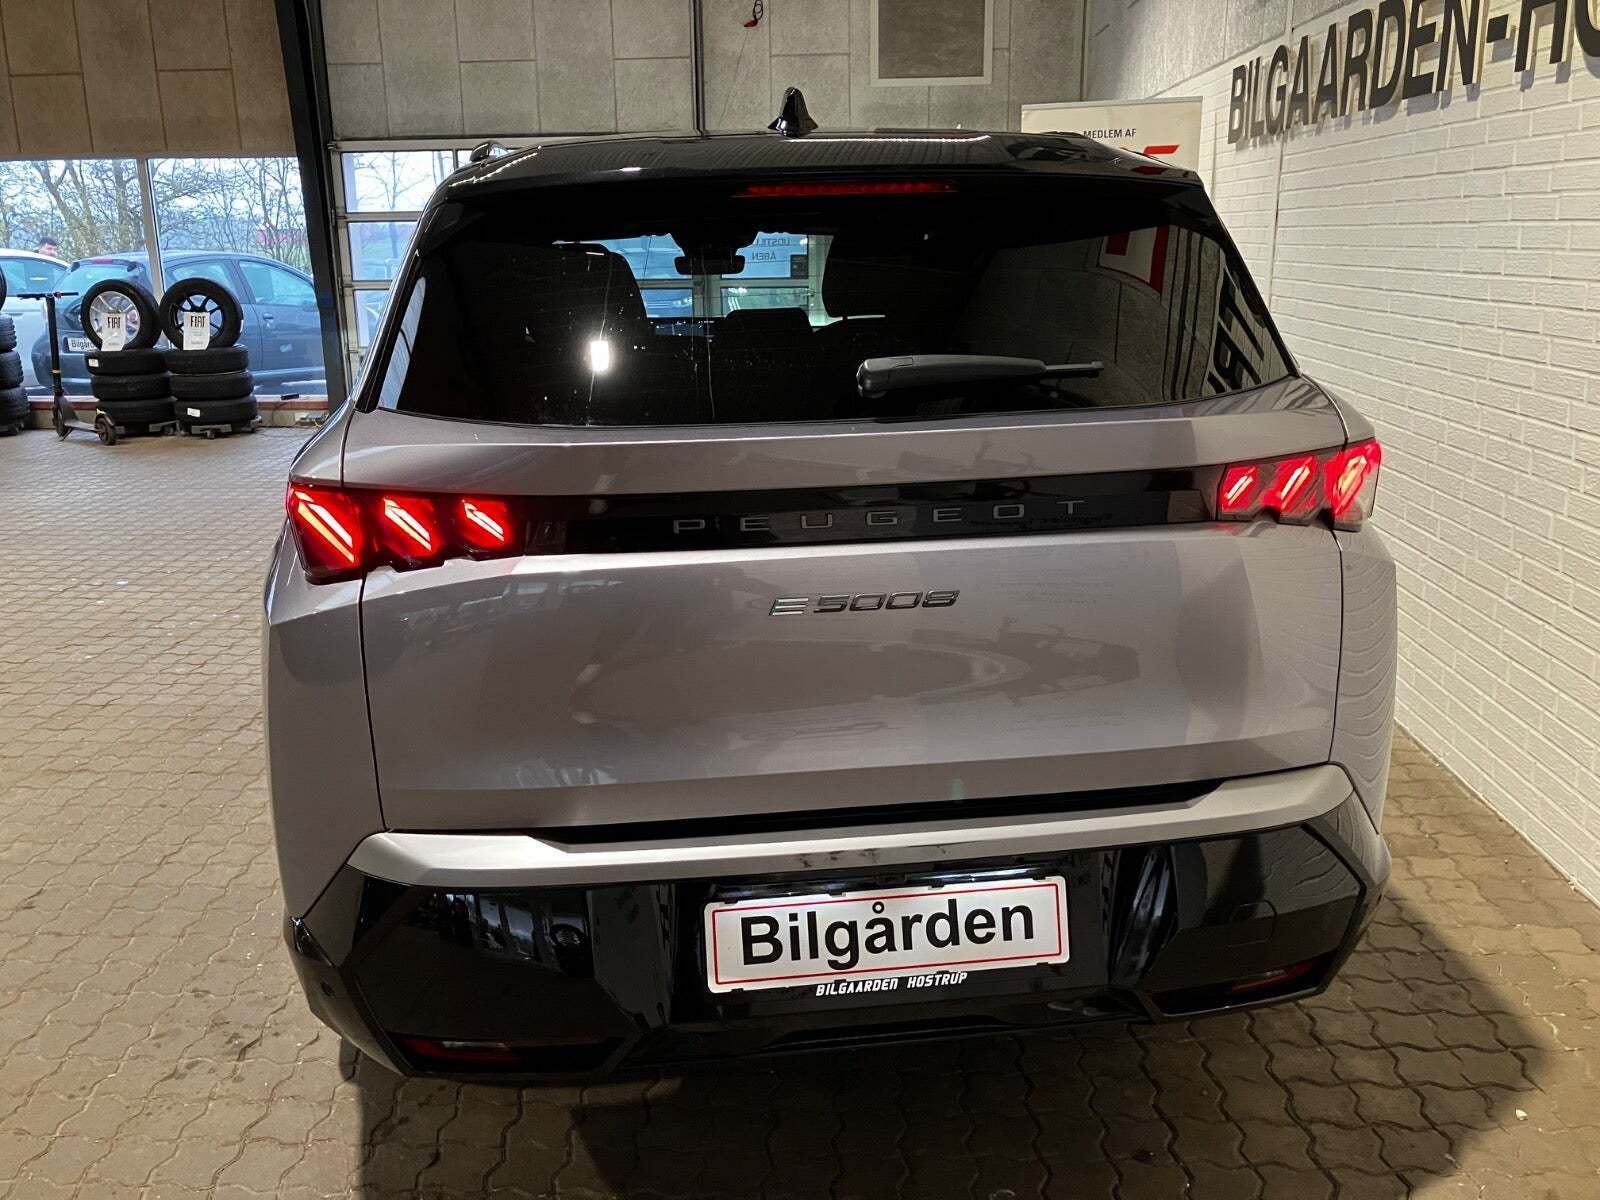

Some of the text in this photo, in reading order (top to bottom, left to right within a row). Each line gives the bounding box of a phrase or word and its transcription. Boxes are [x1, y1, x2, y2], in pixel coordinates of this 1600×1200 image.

[1227, 0, 1600, 144] BILGAARDEN-H
[1083, 128, 1137, 139] MEDLEM AF
[190, 316, 205, 328] FIAT
[673, 500, 1085, 534] PEUGEOT
[740, 899, 1034, 970] Bilgården
[815, 972, 968, 996] BILGAARDEN HOSTRUP
